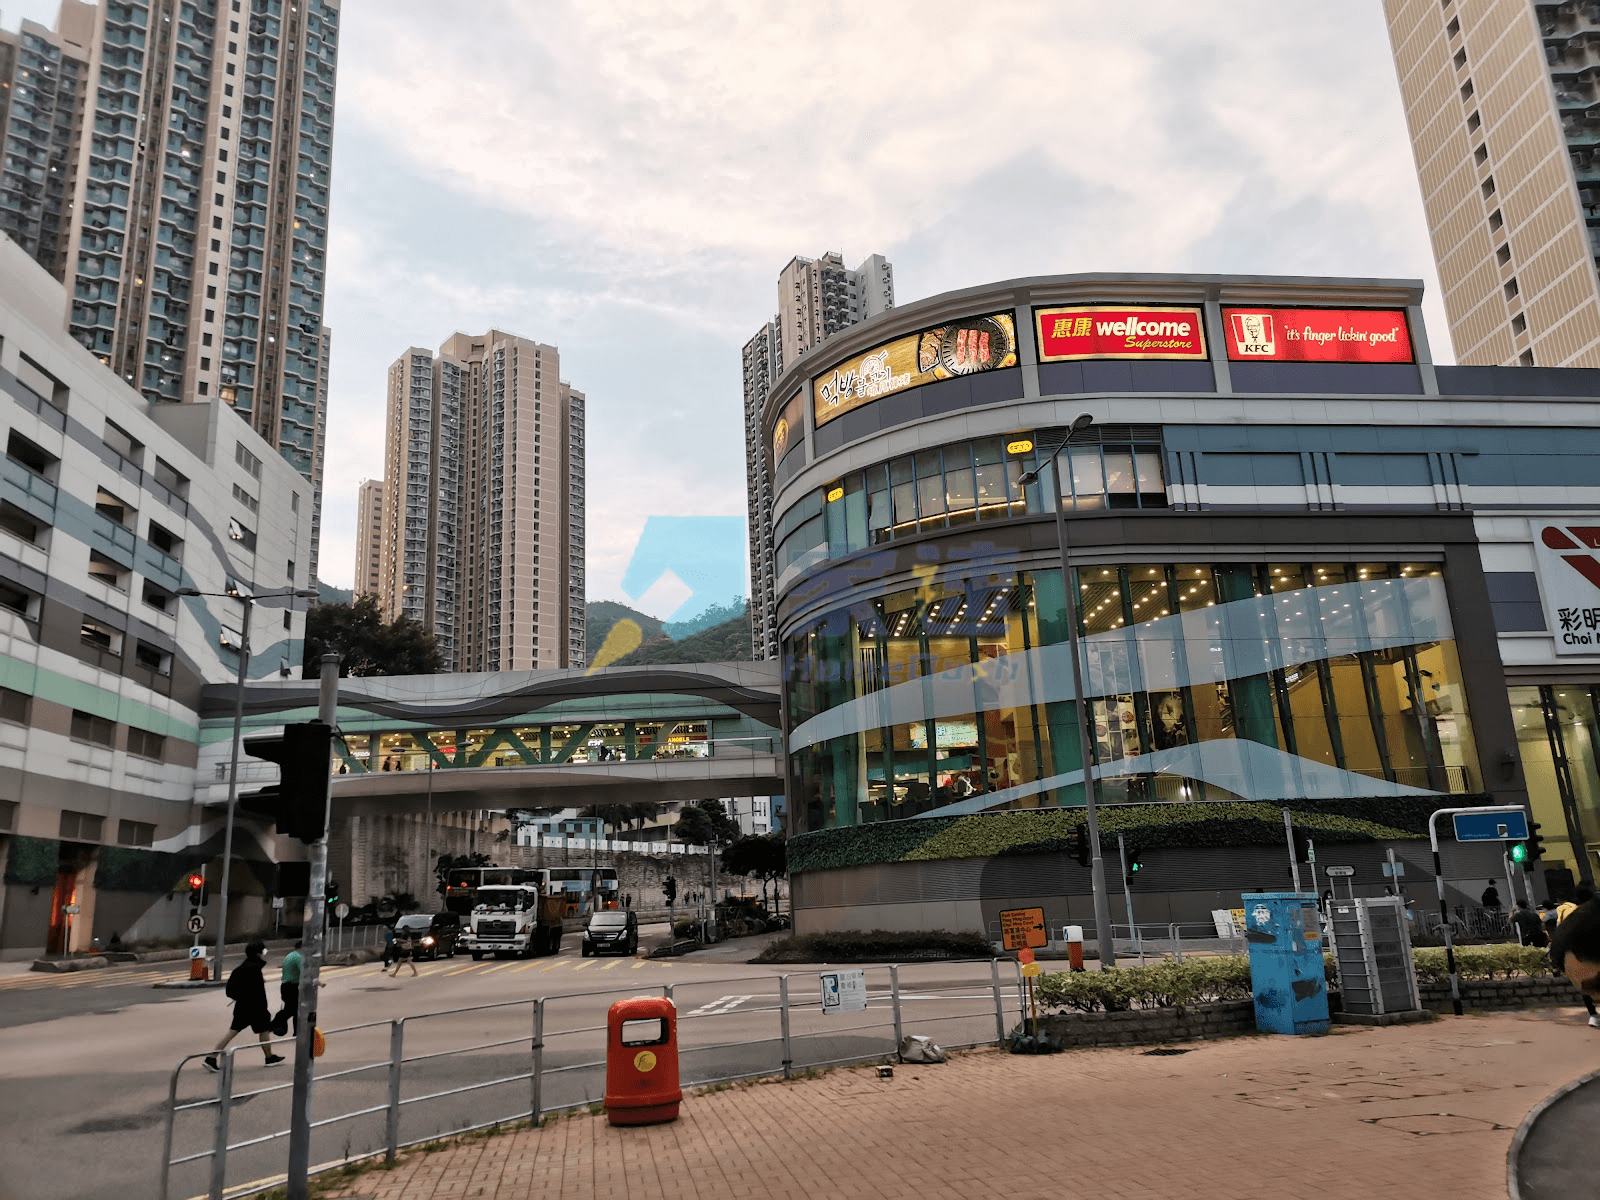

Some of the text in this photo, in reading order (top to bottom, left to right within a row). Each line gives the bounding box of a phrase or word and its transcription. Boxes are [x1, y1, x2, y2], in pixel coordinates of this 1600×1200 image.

[1051, 317, 1093, 339] 惠康
[1096, 317, 1191, 337] wellcome
[1302, 325, 1337, 346] finger
[1124, 336, 1193, 350] Superstore
[1244, 344, 1269, 353] KFC
[821, 370, 859, 406] 먹방
[1563, 632, 1592, 645] Choi
